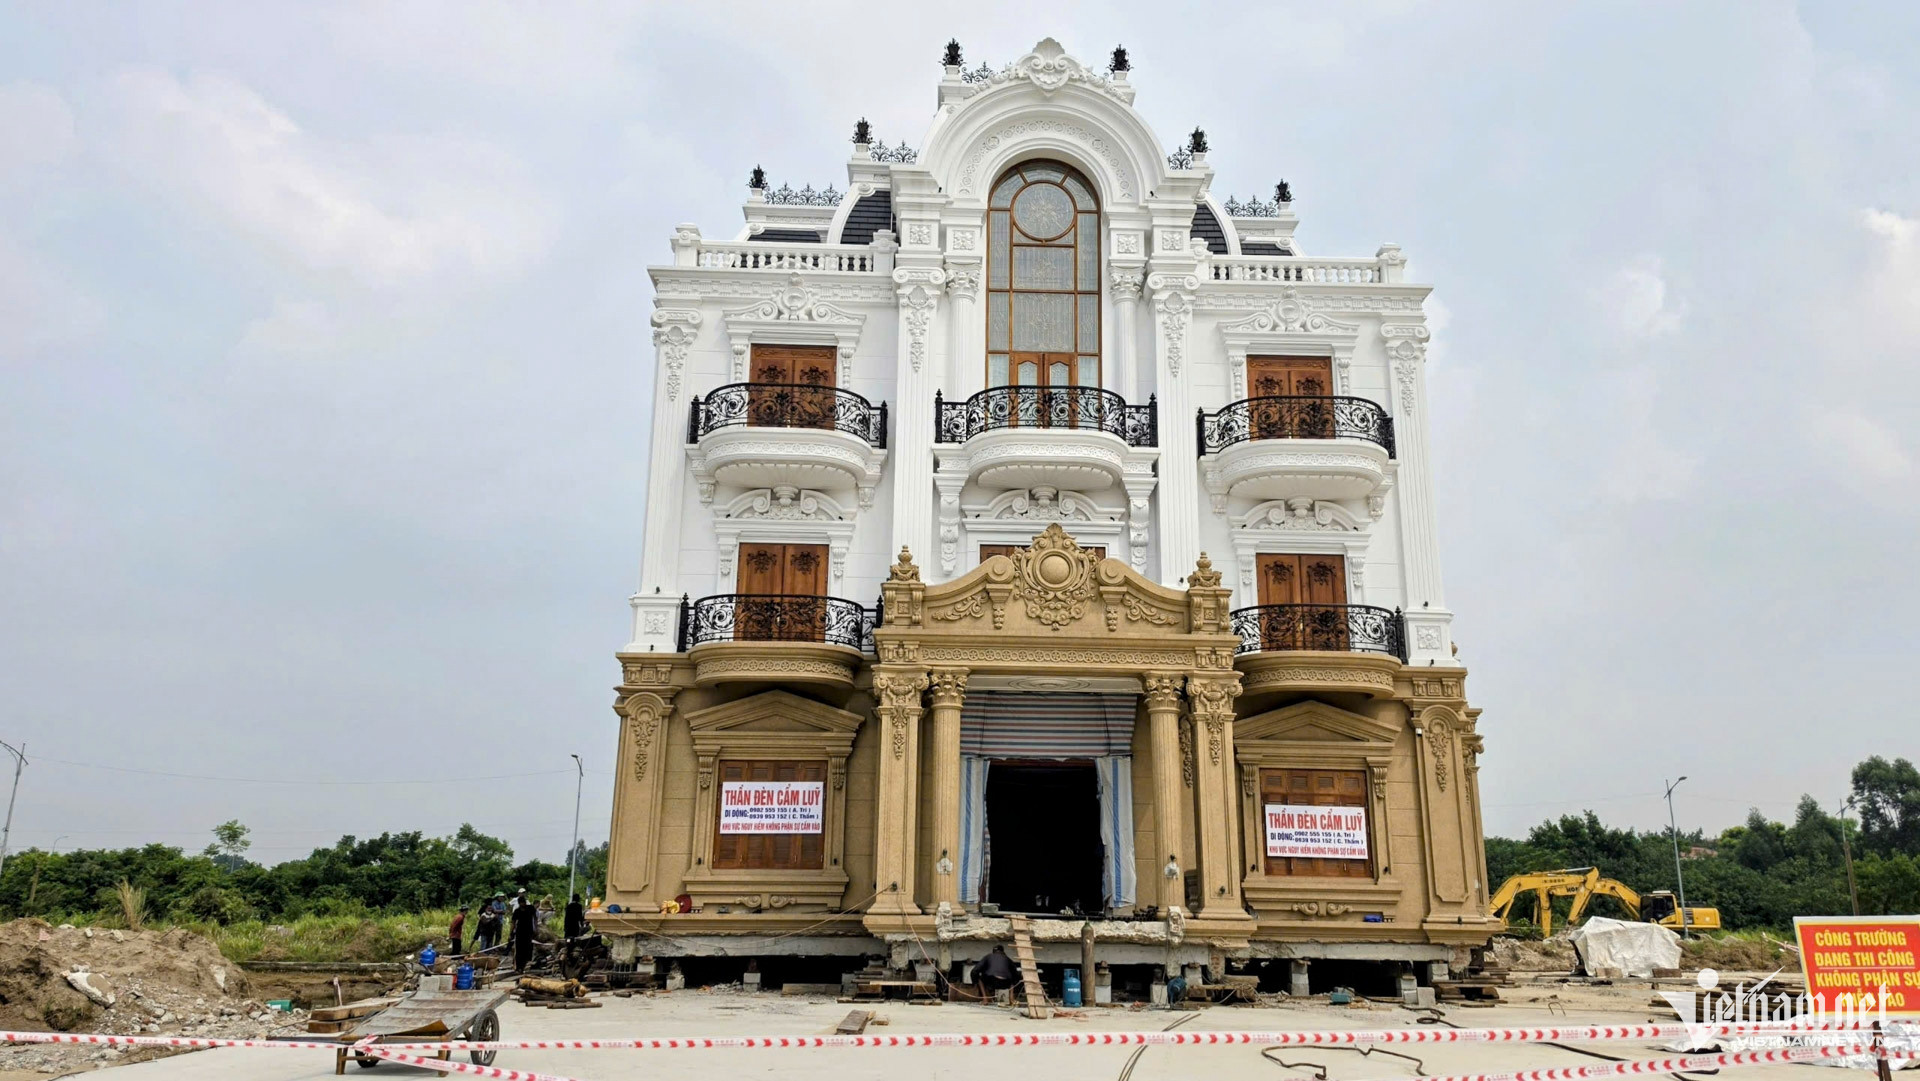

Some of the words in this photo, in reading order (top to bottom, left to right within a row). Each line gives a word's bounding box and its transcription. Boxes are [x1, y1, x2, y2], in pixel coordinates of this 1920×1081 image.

[754, 787, 774, 805] ĐÈN
[777, 784, 799, 805] CẨM
[802, 787, 821, 805] LUỸ
[1297, 811, 1317, 830] ĐÈN
[1320, 809, 1342, 830] CẨM
[1346, 813, 1362, 831] LUỸ
[1815, 929, 1852, 946] CÔNG
[1854, 928, 1907, 946] TRƯỜNG
[1814, 952, 1851, 966] ĐANG
[1853, 952, 1875, 966] THI
[1878, 949, 1915, 966] CÔNG
[1815, 970, 1861, 987] KHÔNG
[1878, 989, 1905, 1007] ÀO
